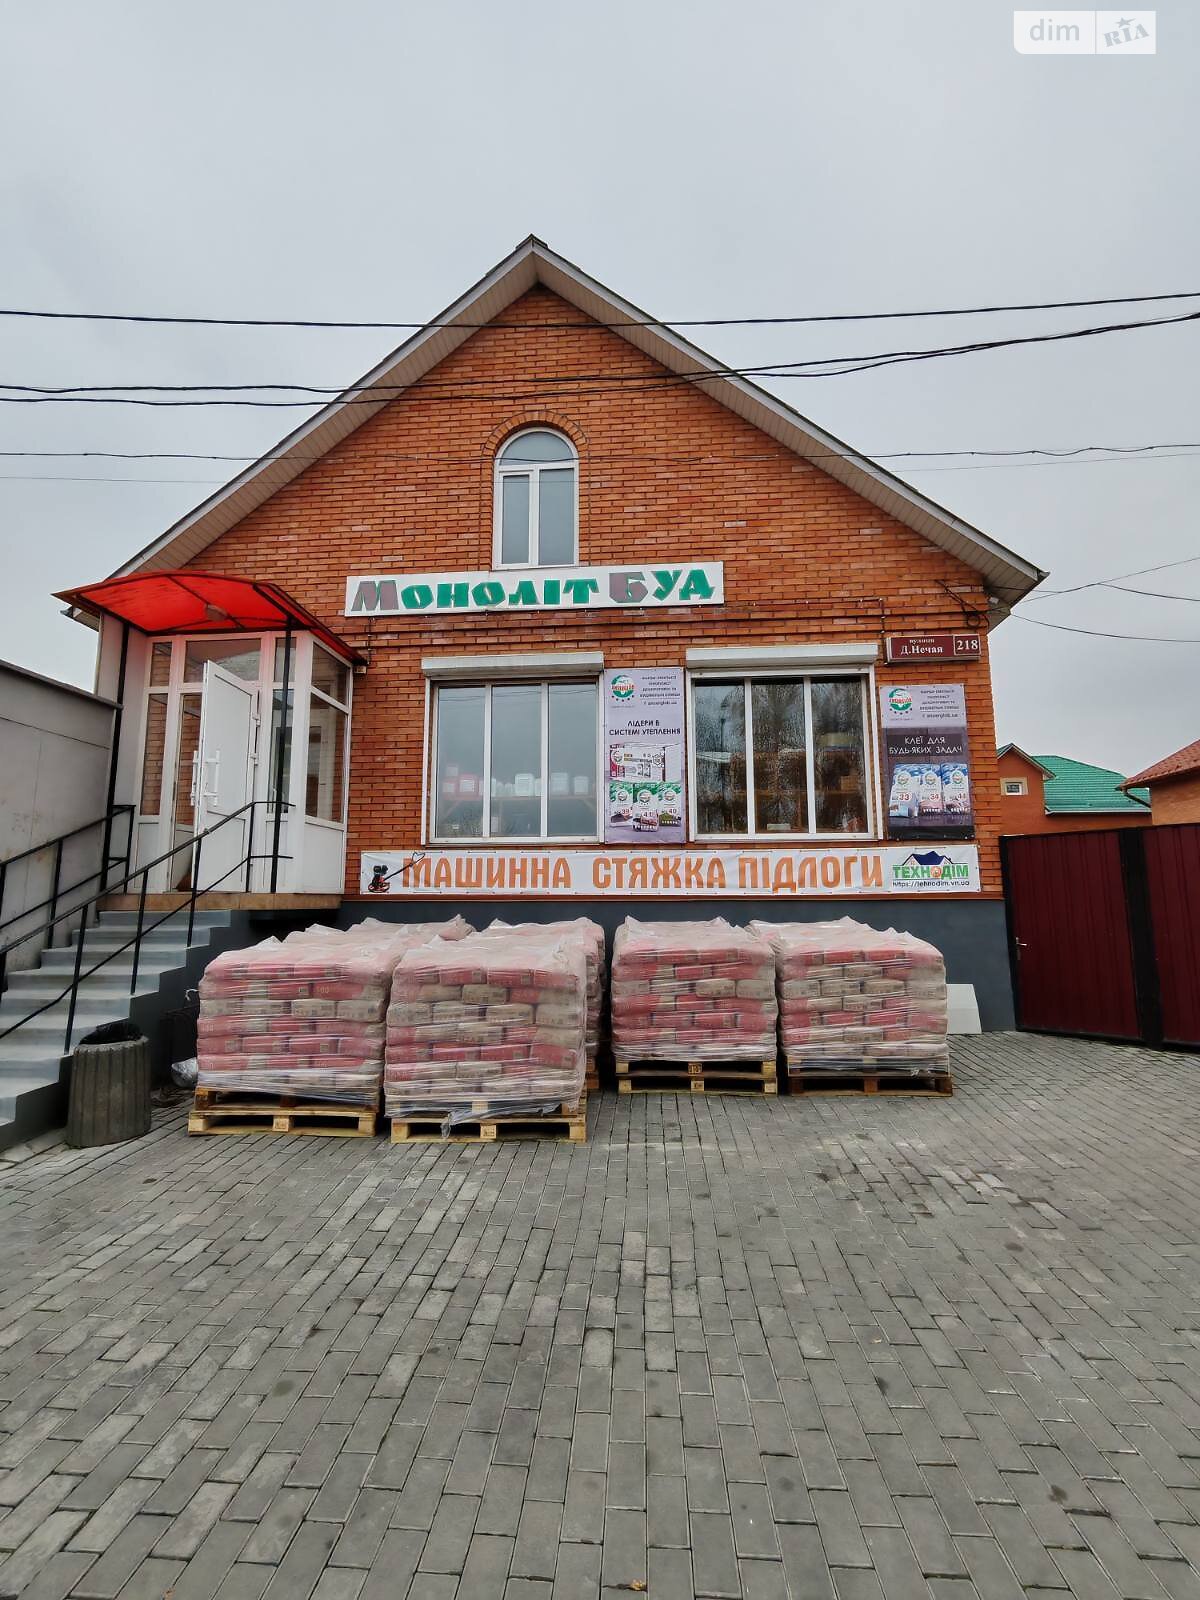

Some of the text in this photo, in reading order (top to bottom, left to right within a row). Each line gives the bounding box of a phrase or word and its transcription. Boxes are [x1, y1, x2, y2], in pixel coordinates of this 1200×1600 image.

[608, 569, 716, 603] БУД
[956, 639, 978, 650] 218
[927, 736, 945, 744] ДЛЯ
[889, 746, 962, 754] БУДЬ-ЯКИХ ЗАДАЧ
[402, 855, 884, 893] МАШИННА СТЯЖКА ПІДЛОГИ
[892, 865, 969, 880] ТЕХНОДІМ
